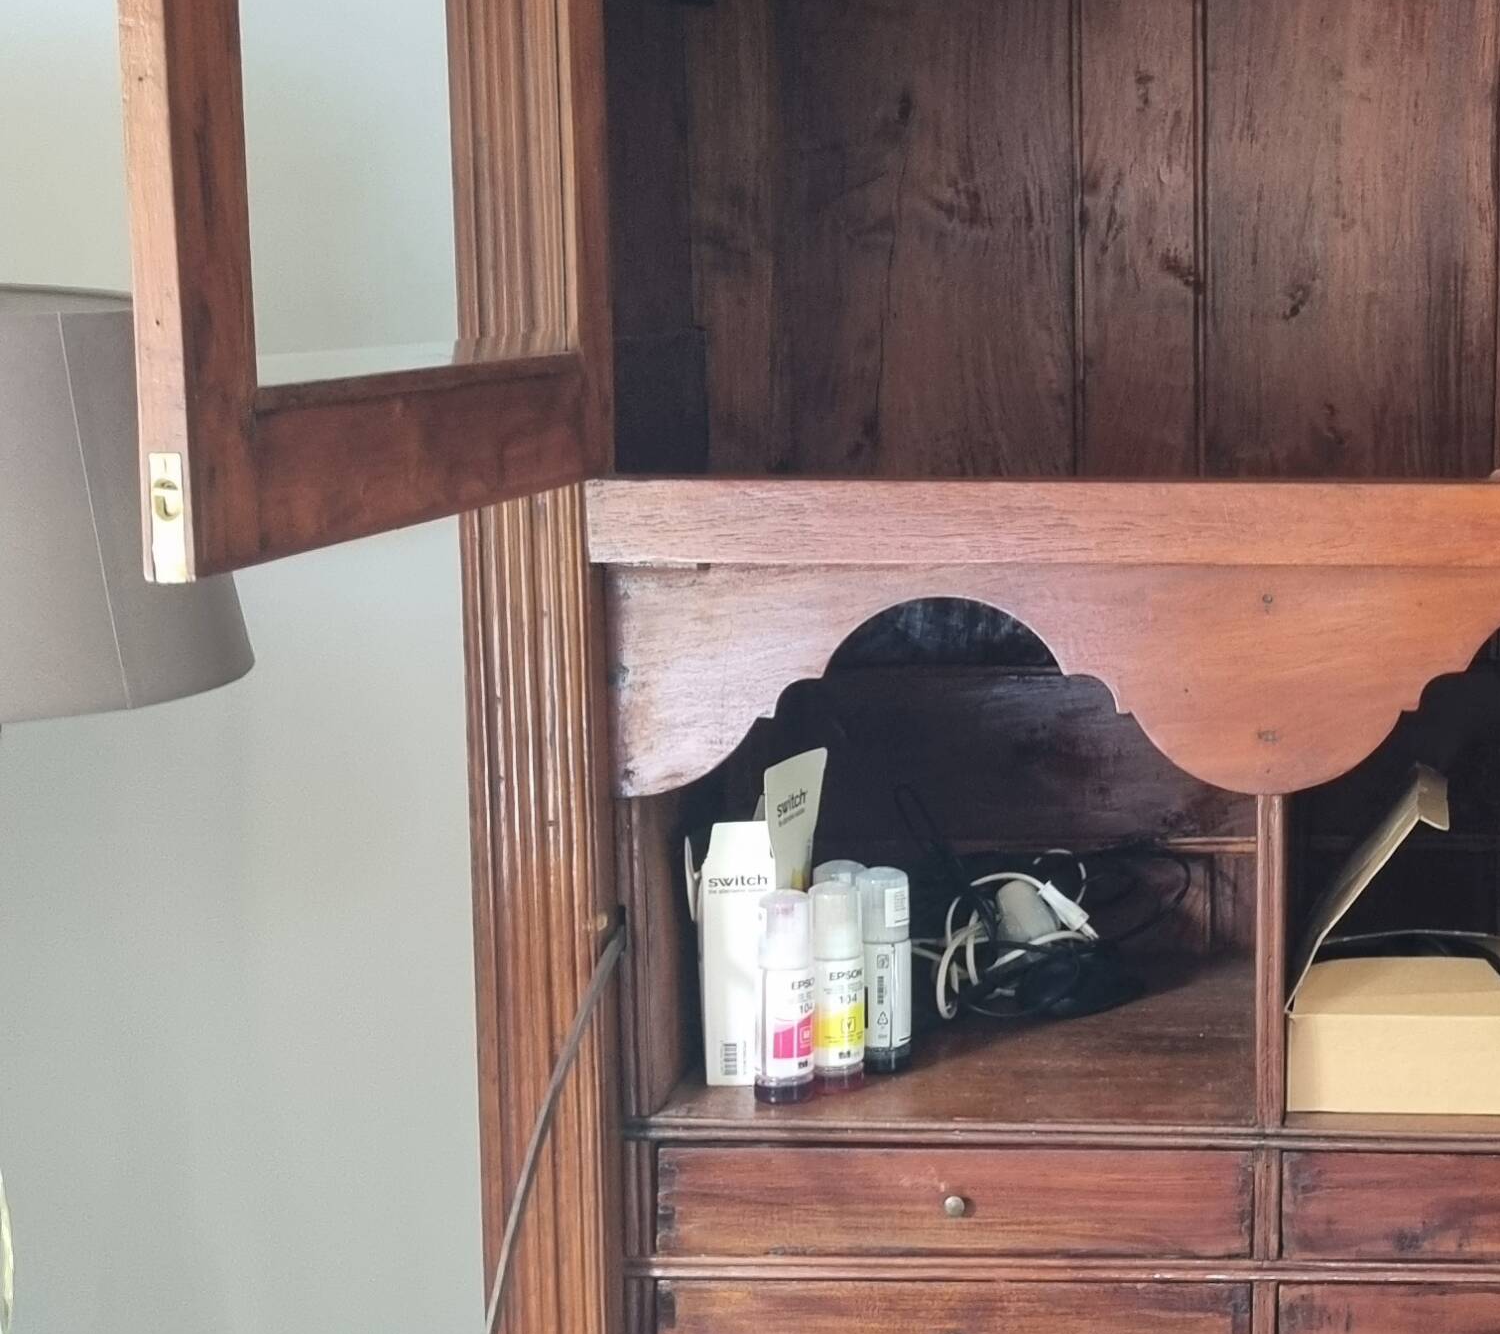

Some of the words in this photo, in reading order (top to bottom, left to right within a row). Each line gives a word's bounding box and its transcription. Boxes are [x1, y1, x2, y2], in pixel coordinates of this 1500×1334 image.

[777, 787, 808, 818] switch
[708, 874, 768, 888] switch
[829, 968, 863, 981] EPSON
[791, 976, 815, 990] EPSO
[839, 993, 857, 1005] 104
